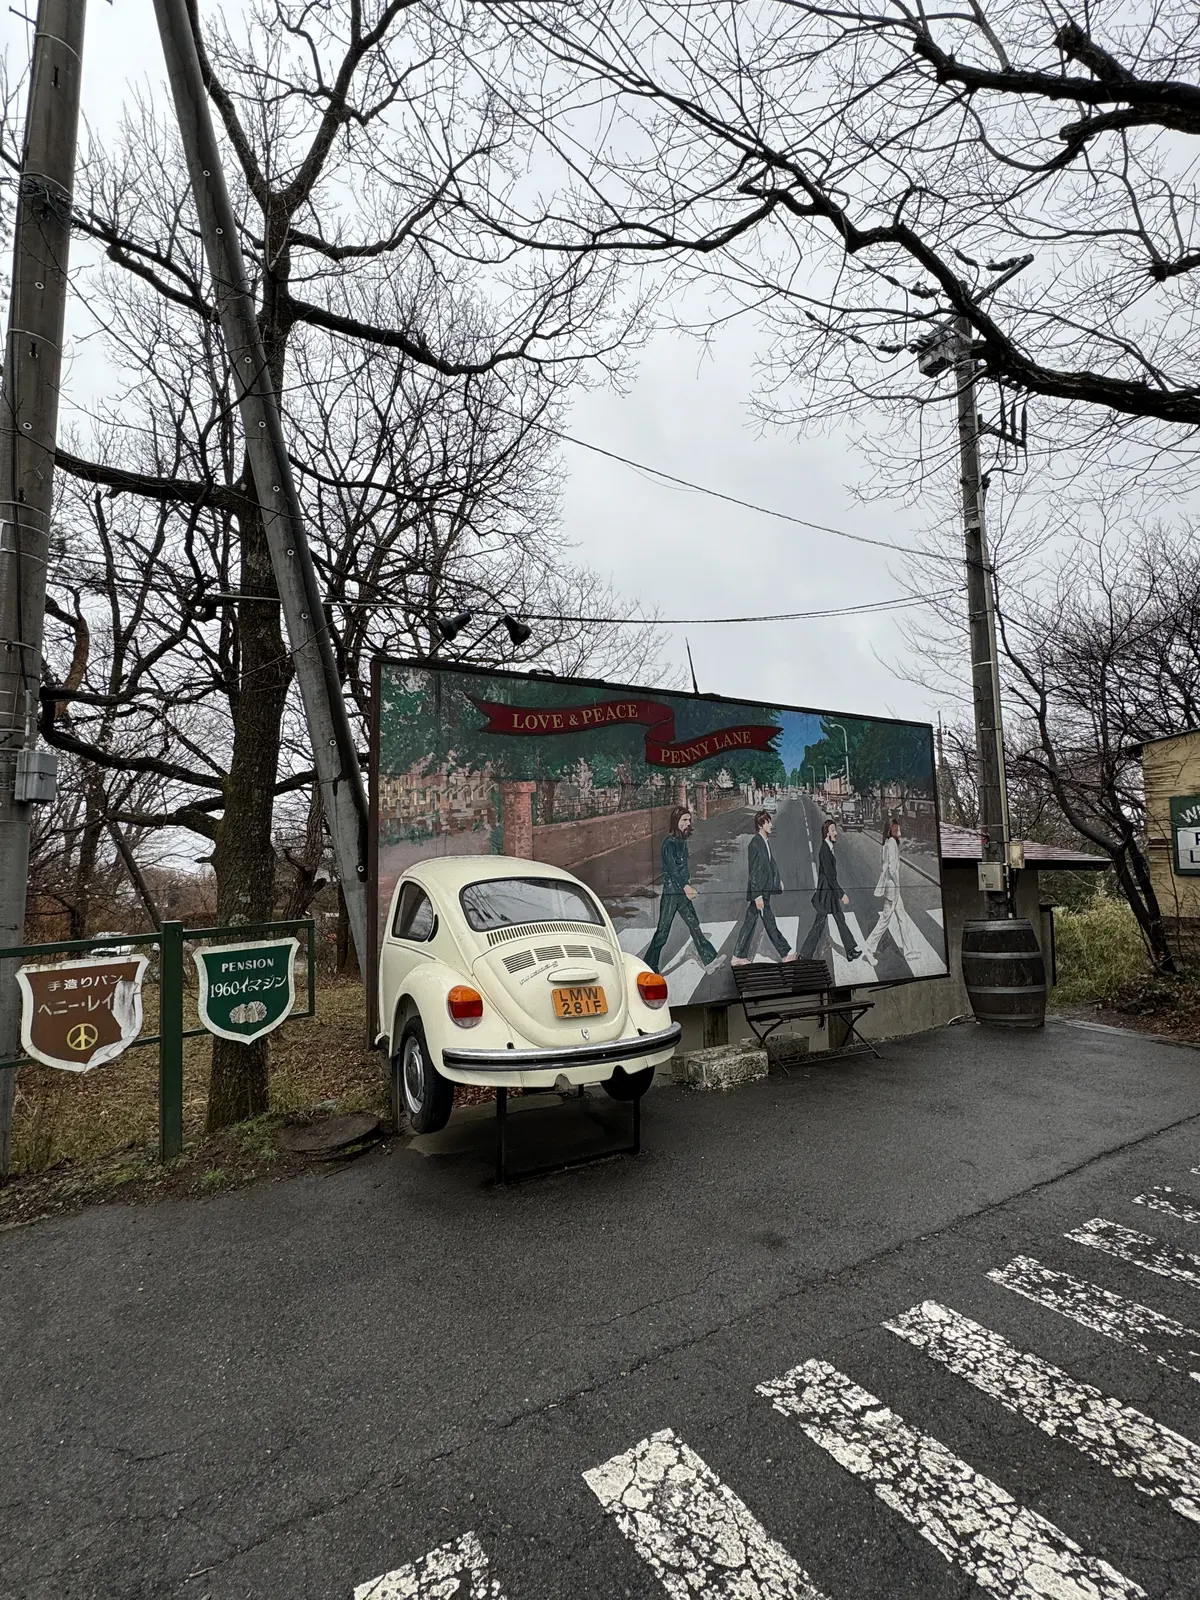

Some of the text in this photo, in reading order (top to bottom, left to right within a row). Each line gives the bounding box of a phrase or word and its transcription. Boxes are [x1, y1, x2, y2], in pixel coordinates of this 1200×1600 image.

[512, 704, 639, 730] LOVE & PEACE
[660, 731, 751, 764] PENNY LANE
[221, 958, 275, 973] PENSION
[559, 987, 598, 1002] LMW
[562, 1000, 602, 1015] 281F
